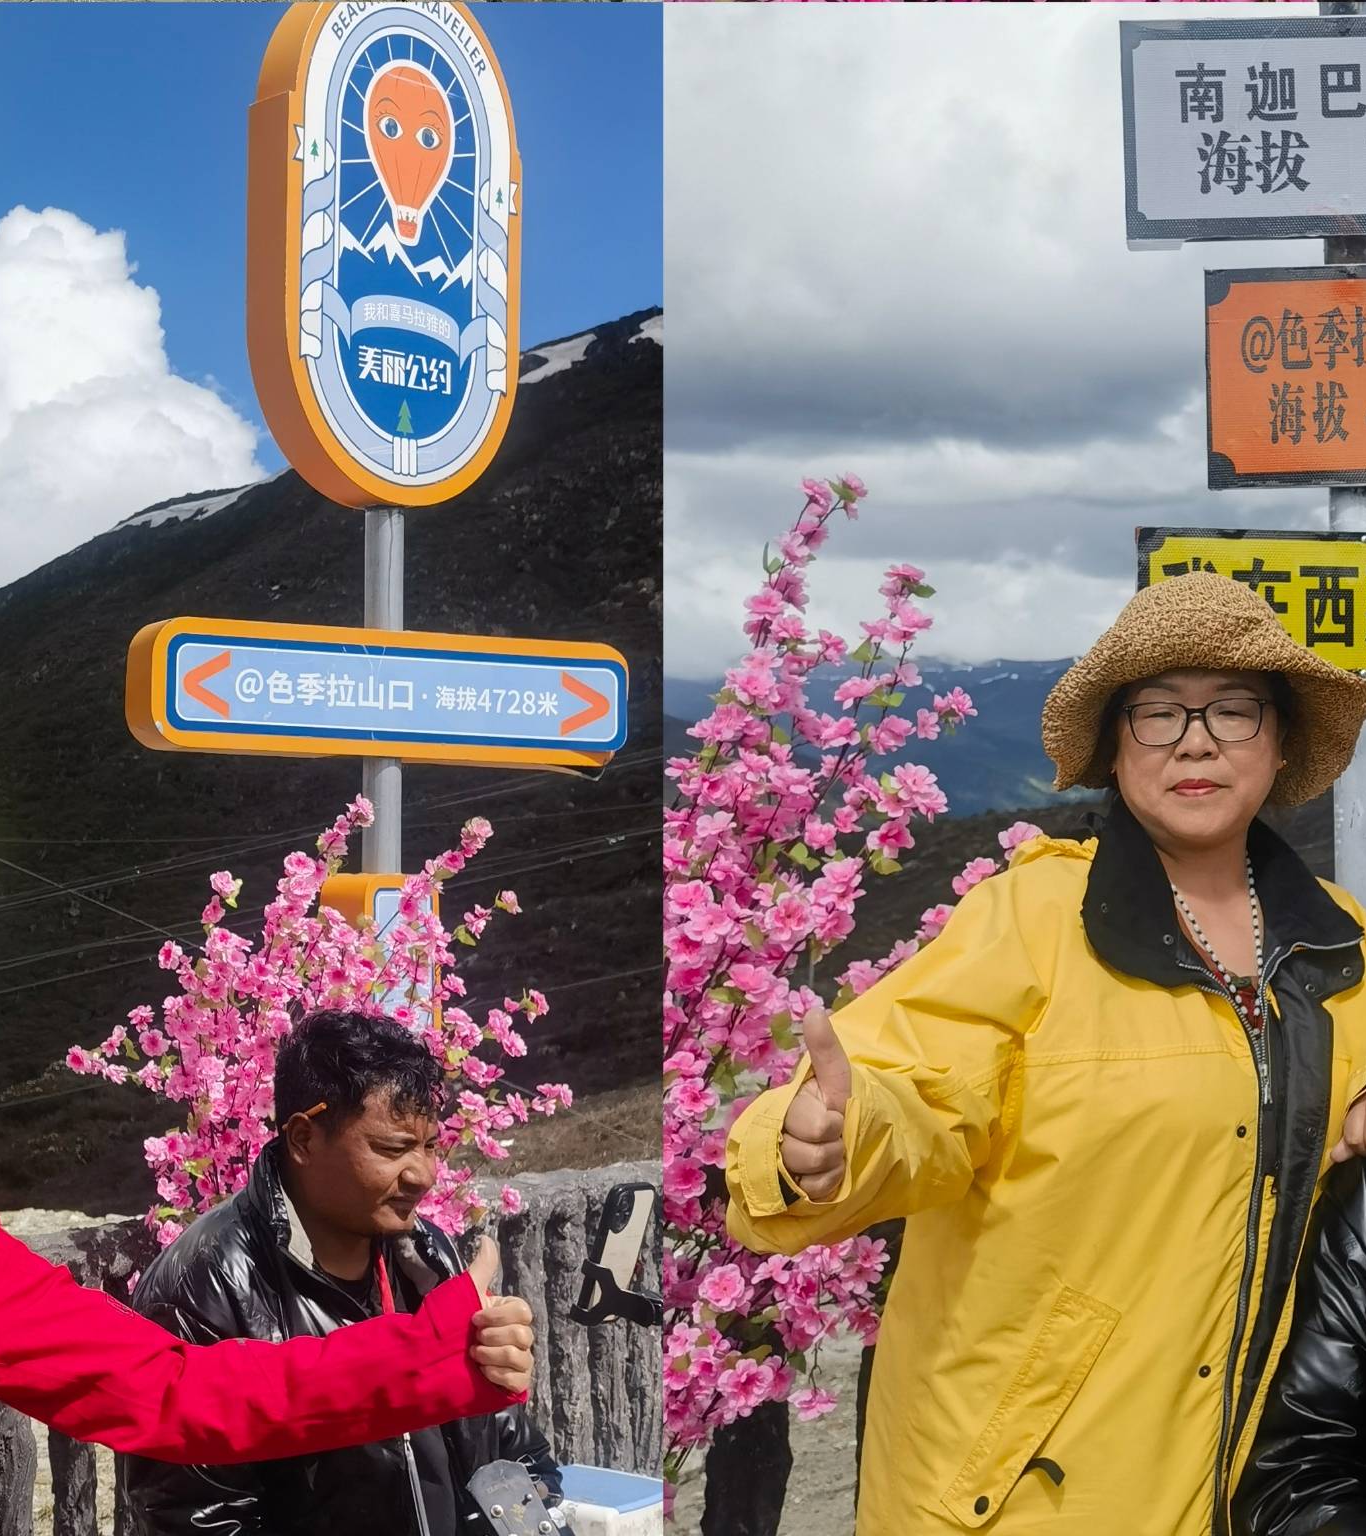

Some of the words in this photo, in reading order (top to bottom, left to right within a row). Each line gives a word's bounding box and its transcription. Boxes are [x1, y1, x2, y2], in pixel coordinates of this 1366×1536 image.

[1196, 130, 1311, 195] 海拔
[363, 302, 452, 341] 我和喜马拉雅的
[357, 344, 453, 396] 美丽公约
[1268, 381, 1349, 446] 海拔
